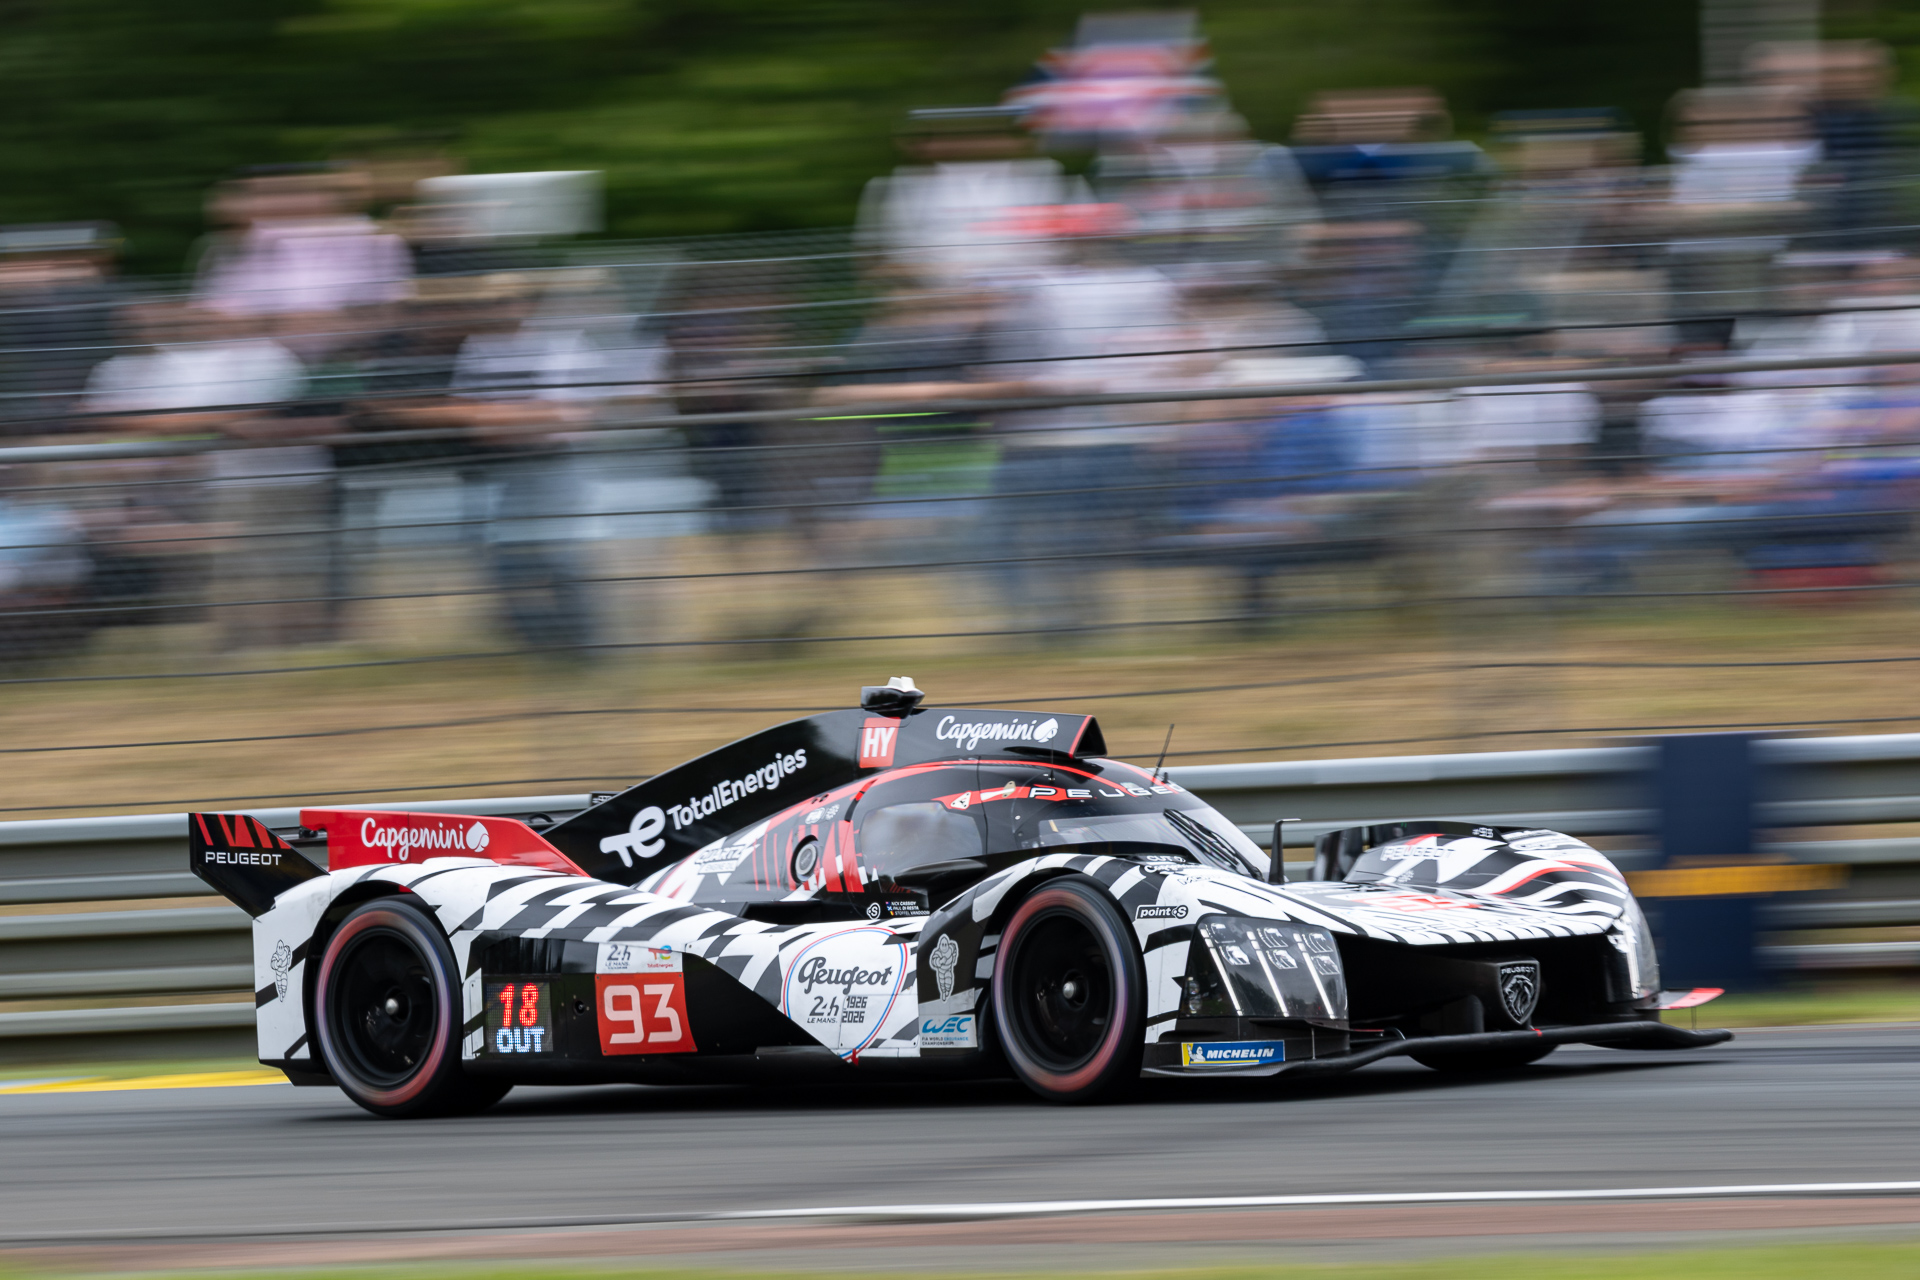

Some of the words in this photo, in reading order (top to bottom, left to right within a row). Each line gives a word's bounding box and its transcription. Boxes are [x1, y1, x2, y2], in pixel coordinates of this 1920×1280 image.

[863, 727, 896, 759] HY
[935, 714, 1036, 751] Capgemini
[666, 748, 808, 830] TotalEnergies
[360, 816, 466, 861] Capgemini
[205, 851, 282, 866] PEUGEOT
[1380, 846, 1456, 862] PEUGEOT
[797, 956, 893, 995] Peugeot
[1501, 966, 1535, 975] PEUGEOT
[499, 982, 539, 1027] 18
[603, 983, 683, 1045] 93
[846, 996, 868, 1009] 1926
[841, 1010, 866, 1024] 2026
[921, 1016, 972, 1034] WEC
[495, 1026, 545, 1053] OUT
[1206, 1048, 1275, 1059] MICHELIN
